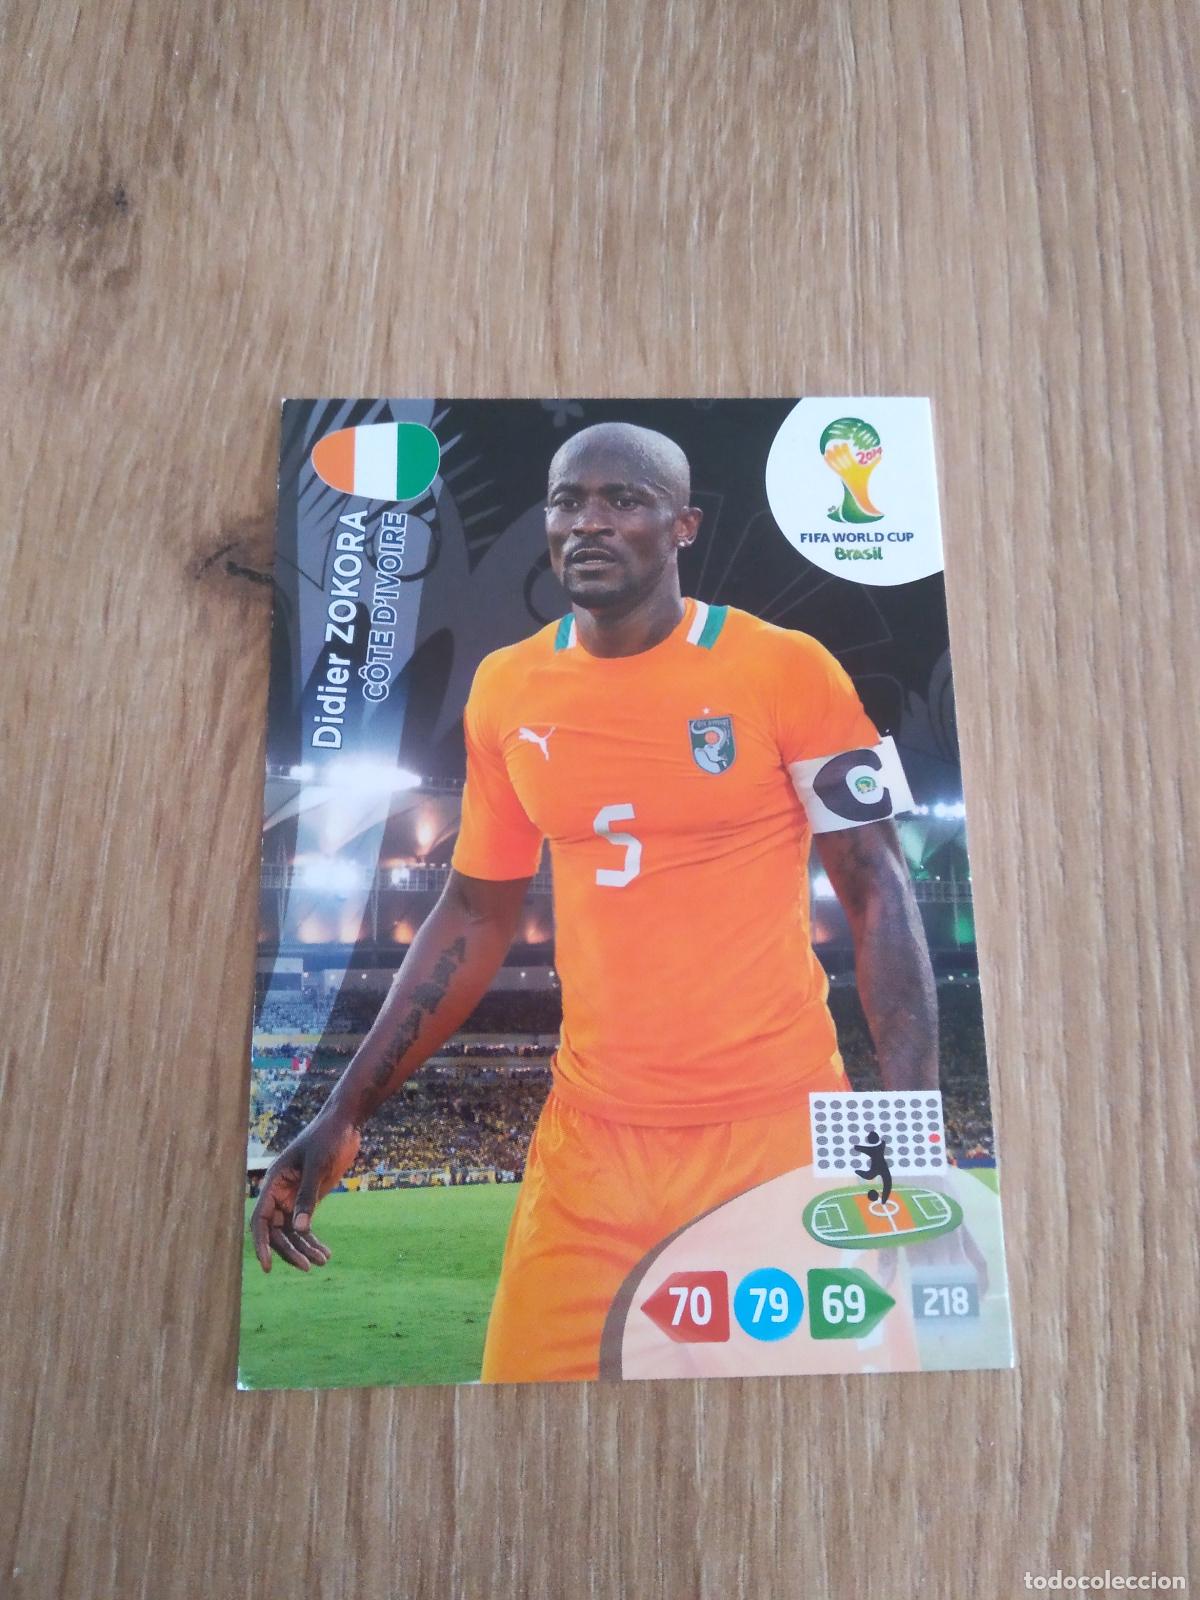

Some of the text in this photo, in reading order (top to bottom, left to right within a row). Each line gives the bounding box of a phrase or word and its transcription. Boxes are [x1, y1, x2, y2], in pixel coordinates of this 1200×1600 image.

[800, 532, 914, 543] FIFA WORLD CUP
[834, 547, 883, 560] Brasil
[311, 510, 369, 750] Didier ZOKORA
[358, 511, 408, 702] CÔTE D'IVOIRE
[593, 803, 643, 887] 5
[668, 1283, 970, 1326] 70 79 69 218
